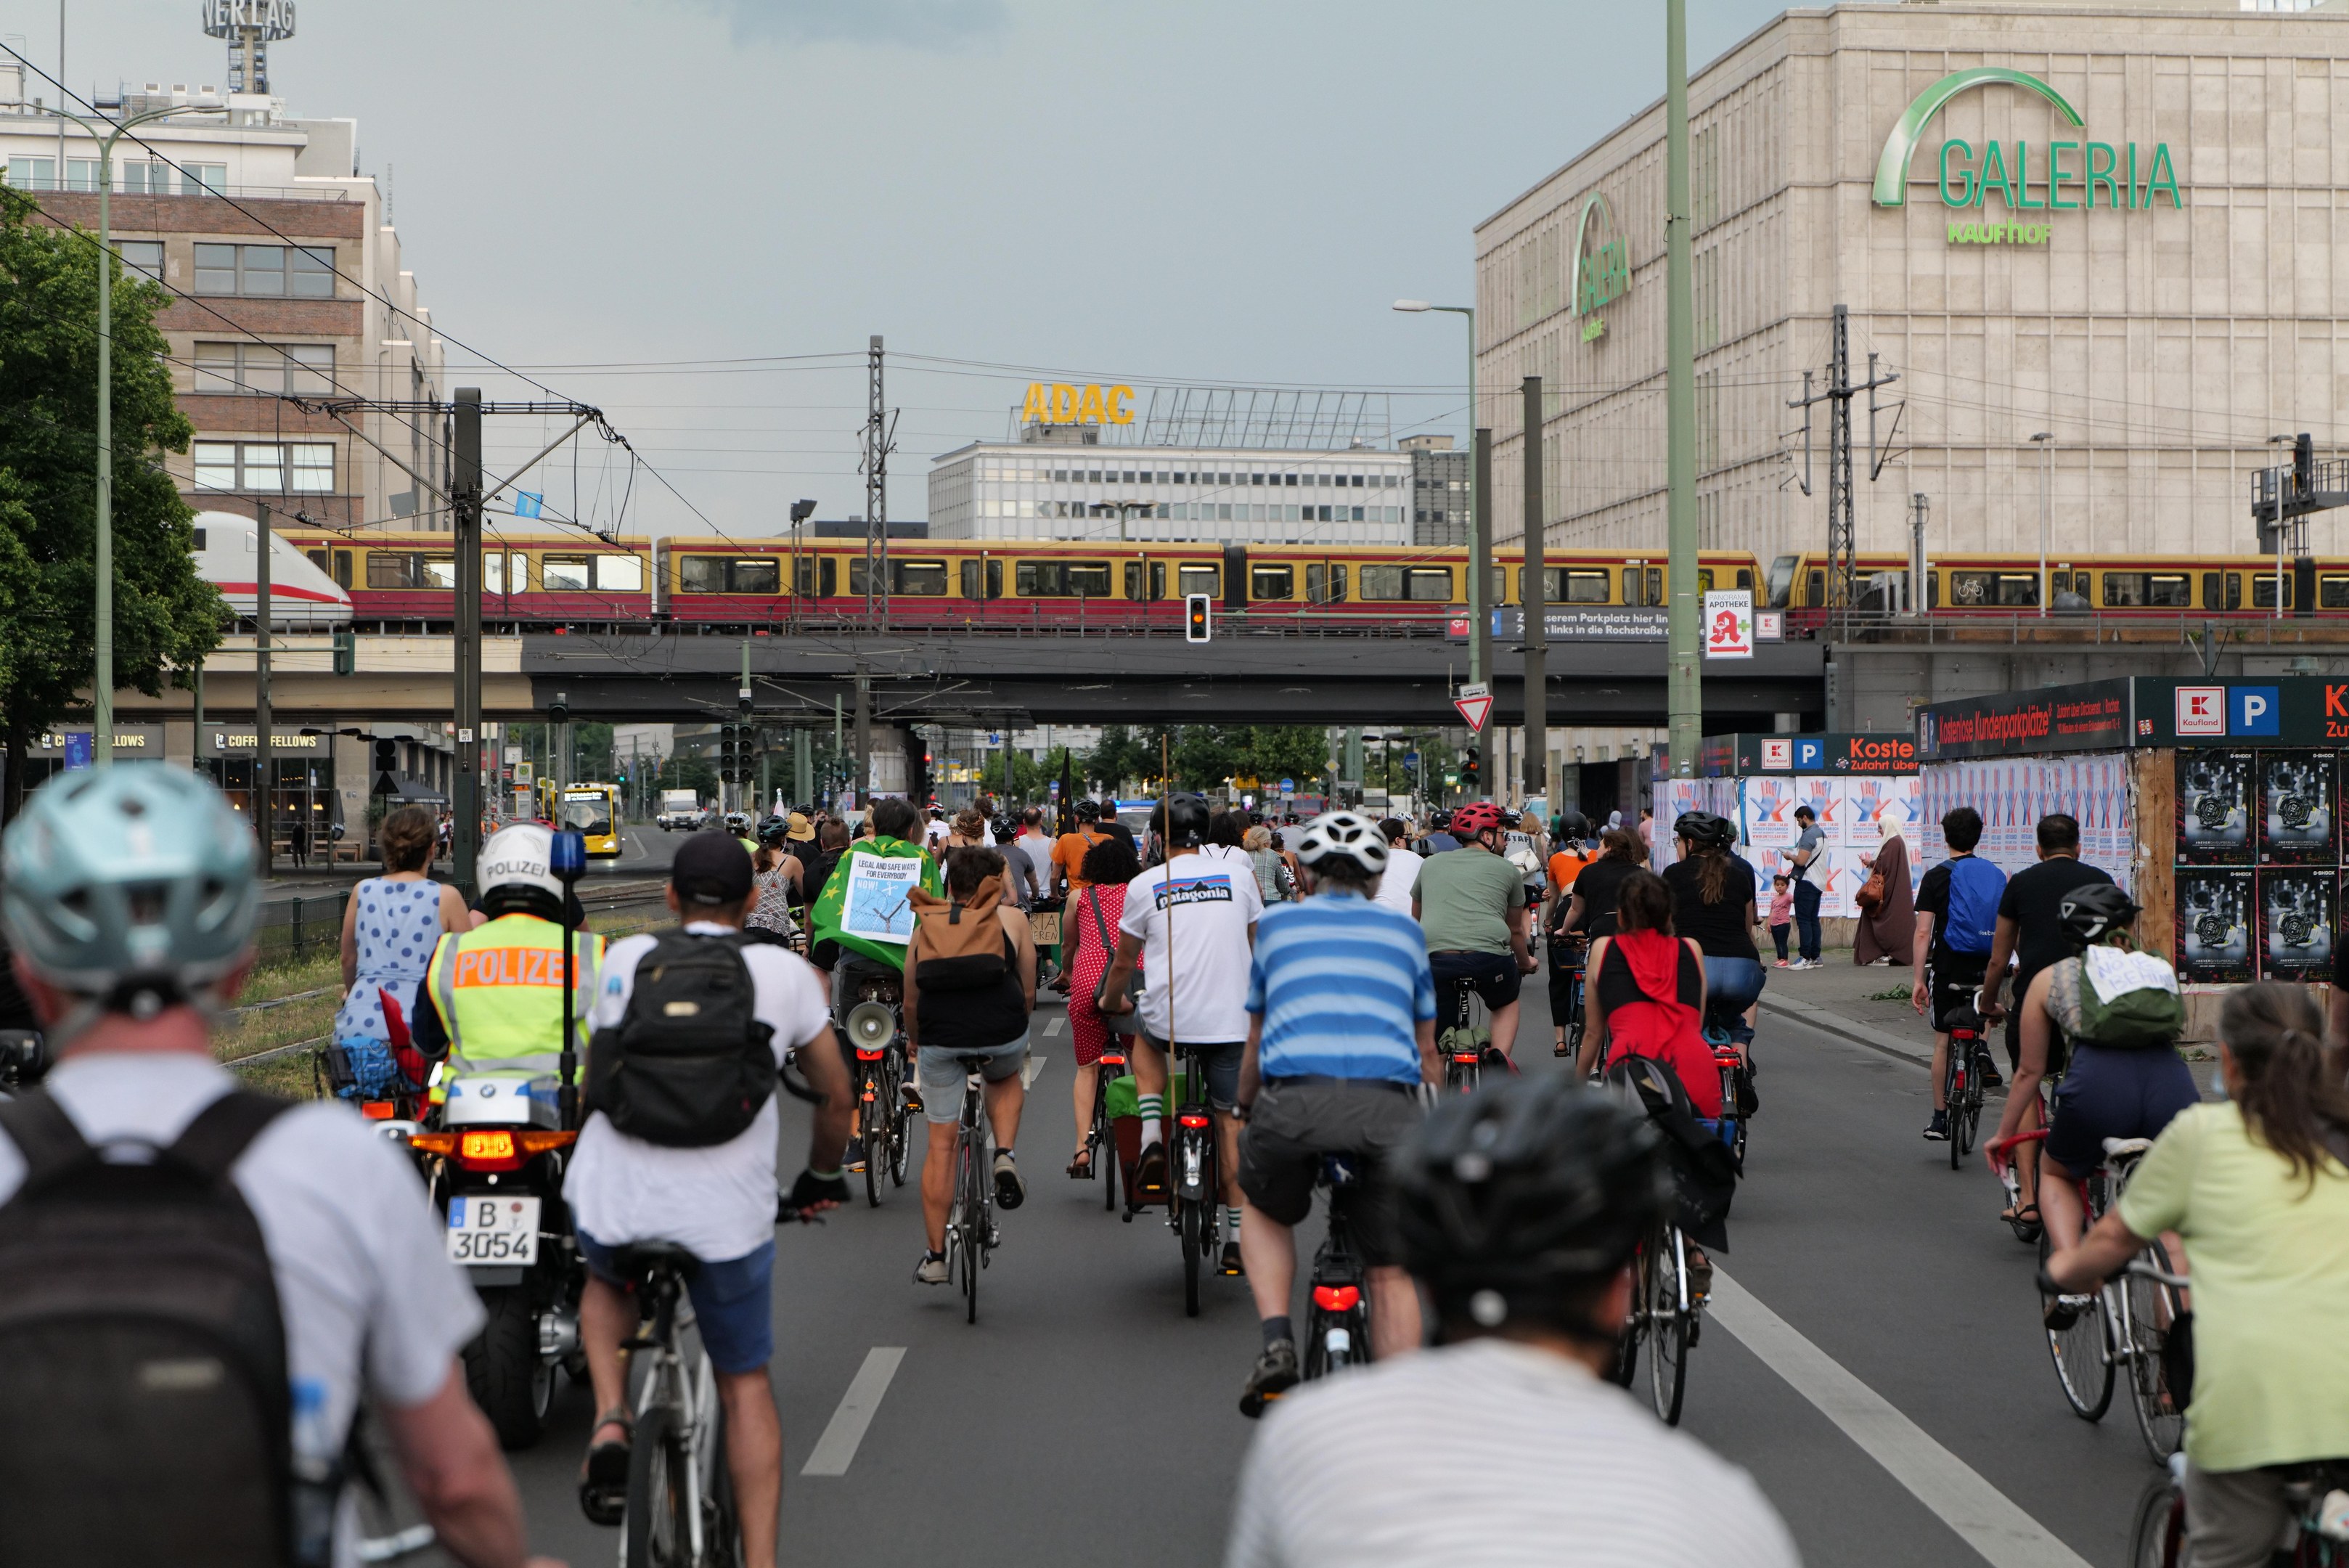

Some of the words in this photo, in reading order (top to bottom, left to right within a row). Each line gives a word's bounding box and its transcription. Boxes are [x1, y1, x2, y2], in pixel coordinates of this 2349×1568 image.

[205, 0, 293, 30] VERLAG
[1939, 139, 2183, 209] GALERIA
[1022, 382, 1135, 425] ADAC
[1580, 613, 1630, 625] Parkplatz
[1633, 613, 1654, 623] hier
[1656, 614, 1668, 623] lin
[1551, 625, 1574, 634] links
[1576, 626, 1585, 634] in
[1588, 625, 1602, 634] die
[1606, 625, 1663, 635] Rochstraße
[2244, 695, 2267, 726] P
[1939, 713, 1974, 745] Kostenlose
[229, 735, 258, 747] COFF
[271, 735, 316, 747] FELLOWS
[1851, 738, 1914, 759] Koste
[1802, 744, 1816, 764] P
[1851, 760, 1890, 770] Zufahrt
[1892, 760, 1919, 770] über
[487, 861, 547, 879] POLIZEI
[859, 859, 875, 869] LEGAL
[857, 879, 878, 890] NOW!
[877, 871, 907, 880] EVERYBODY
[1159, 887, 1229, 908] patagonia
[1030, 914, 1057, 932] RIA
[457, 950, 564, 987] POLIZE
[478, 1202, 497, 1228] B
[454, 1232, 529, 1259] 3054
